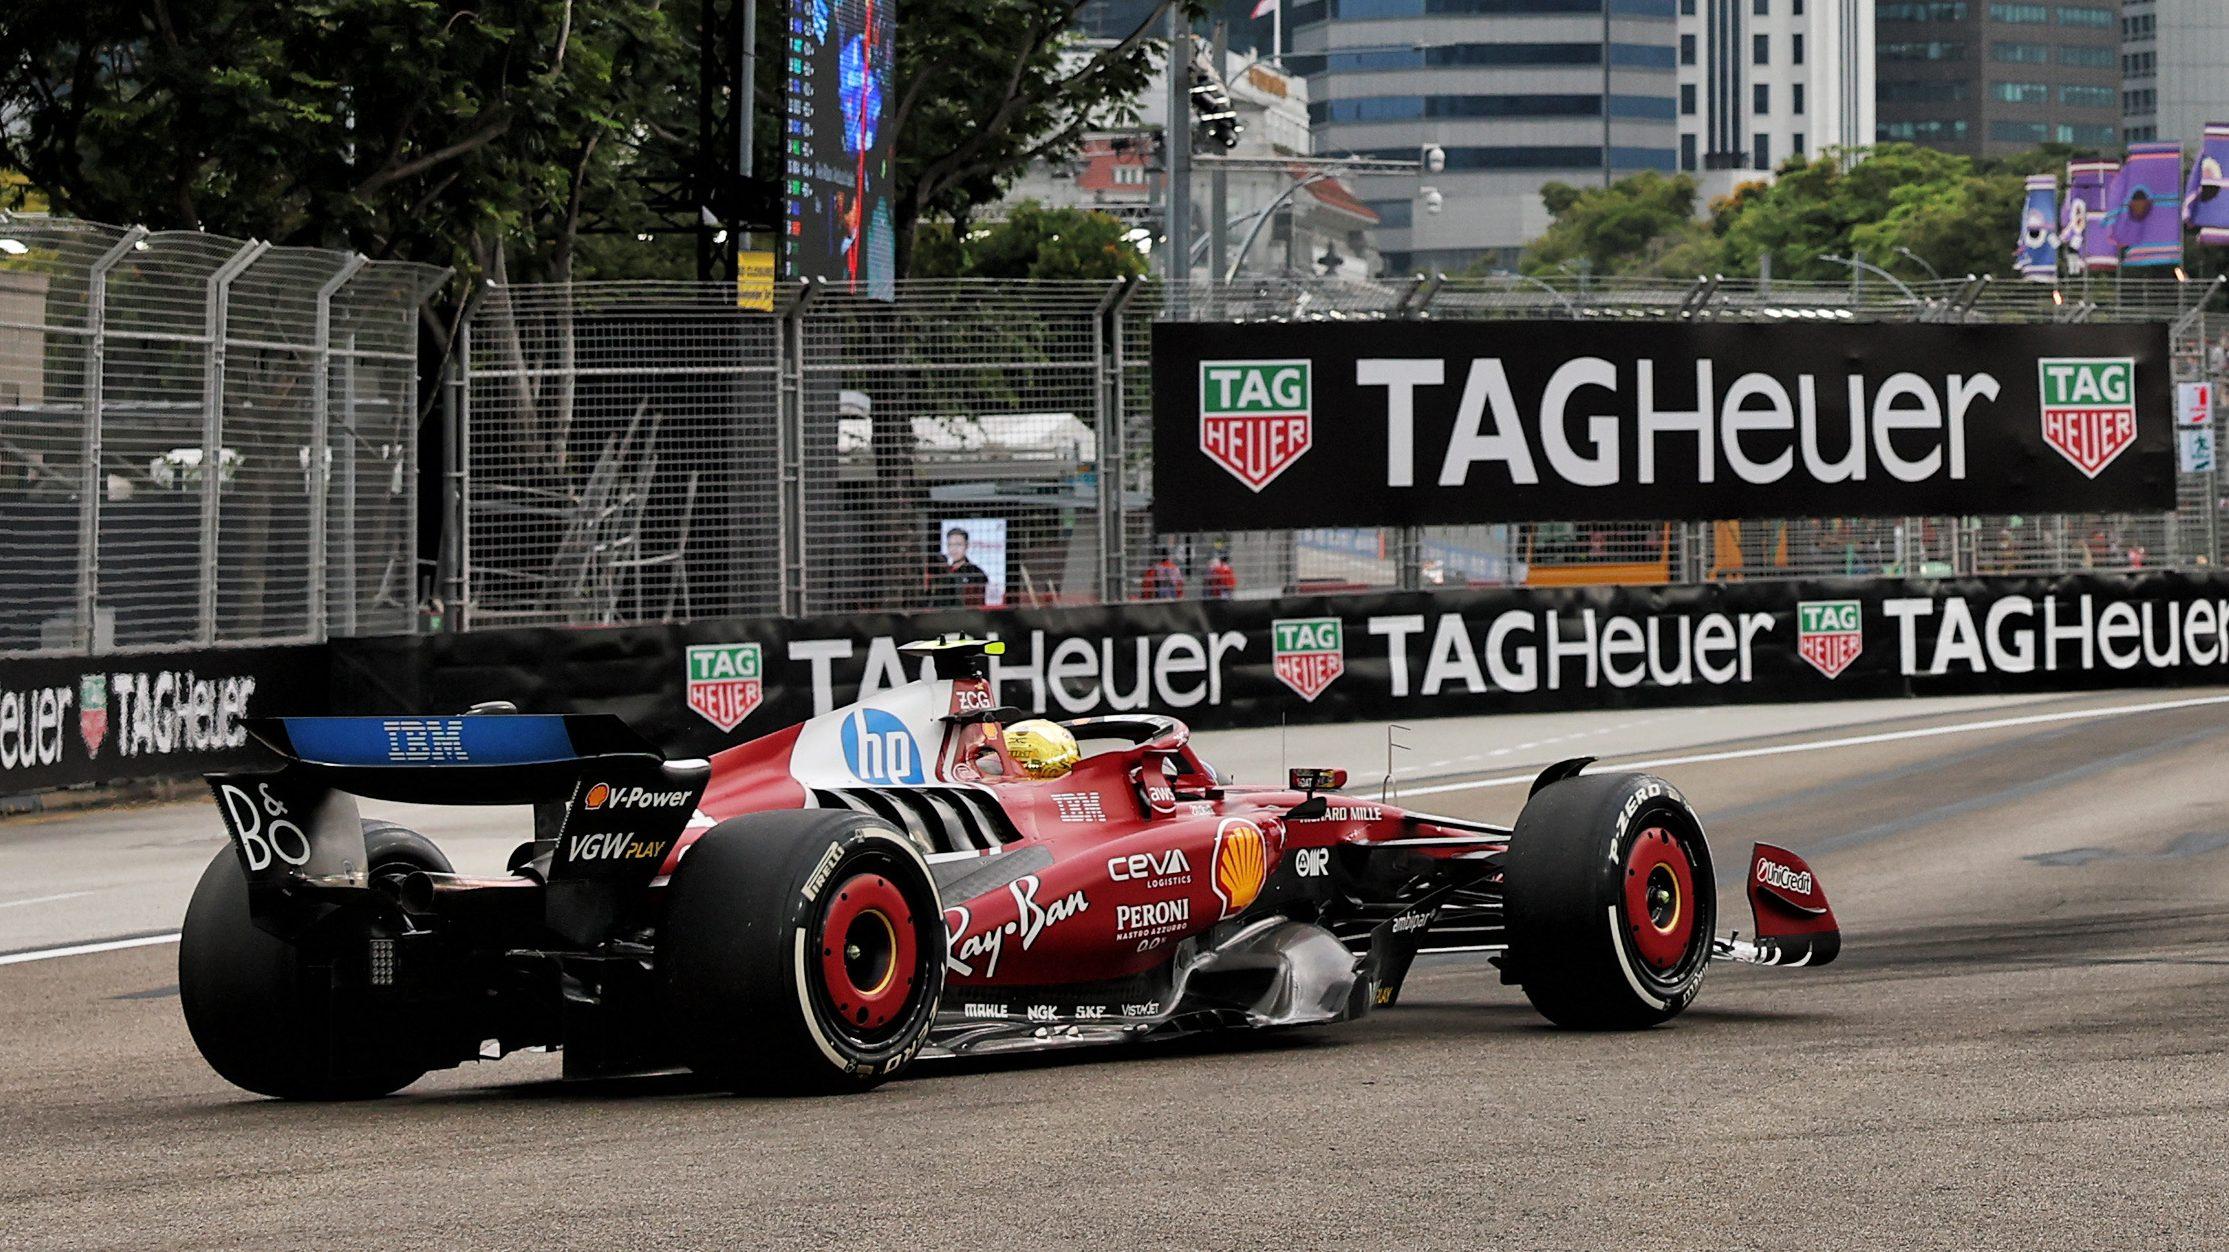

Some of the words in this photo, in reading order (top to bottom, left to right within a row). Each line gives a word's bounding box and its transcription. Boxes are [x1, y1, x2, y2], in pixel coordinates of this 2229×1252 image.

[1209, 368, 1301, 409] TAG
[2047, 366, 2128, 403] TAG
[1206, 418, 1305, 481] HEUER
[2047, 411, 2131, 467] HEUER
[1804, 604, 1857, 631] TAG
[1277, 622, 1336, 650] TAG
[693, 650, 756, 679] TAG
[1800, 636, 1860, 674] HEUER
[788, 629, 1248, 720] TAHeuer
[1275, 654, 1342, 695] HEUER
[692, 683, 758, 724] HEUER
[956, 690, 991, 710] ZCG
[383, 720, 469, 761] IBM
[854, 708, 911, 785] hp
[608, 787, 692, 809] V-Power
[1051, 792, 1107, 822] IBM
[1350, 806, 1383, 821] MILLE
[800, 841, 845, 902] PIRELLI
[1147, 875, 1192, 888] LOGISTICS
[1767, 861, 1812, 896] UniCredit
[1116, 898, 1189, 931] PERONI
[1392, 911, 1431, 934] ambipar
[964, 1003, 1009, 1019] MAHLE
[1027, 1005, 1060, 1021] NGK
[1074, 1005, 1106, 1019] SKF
